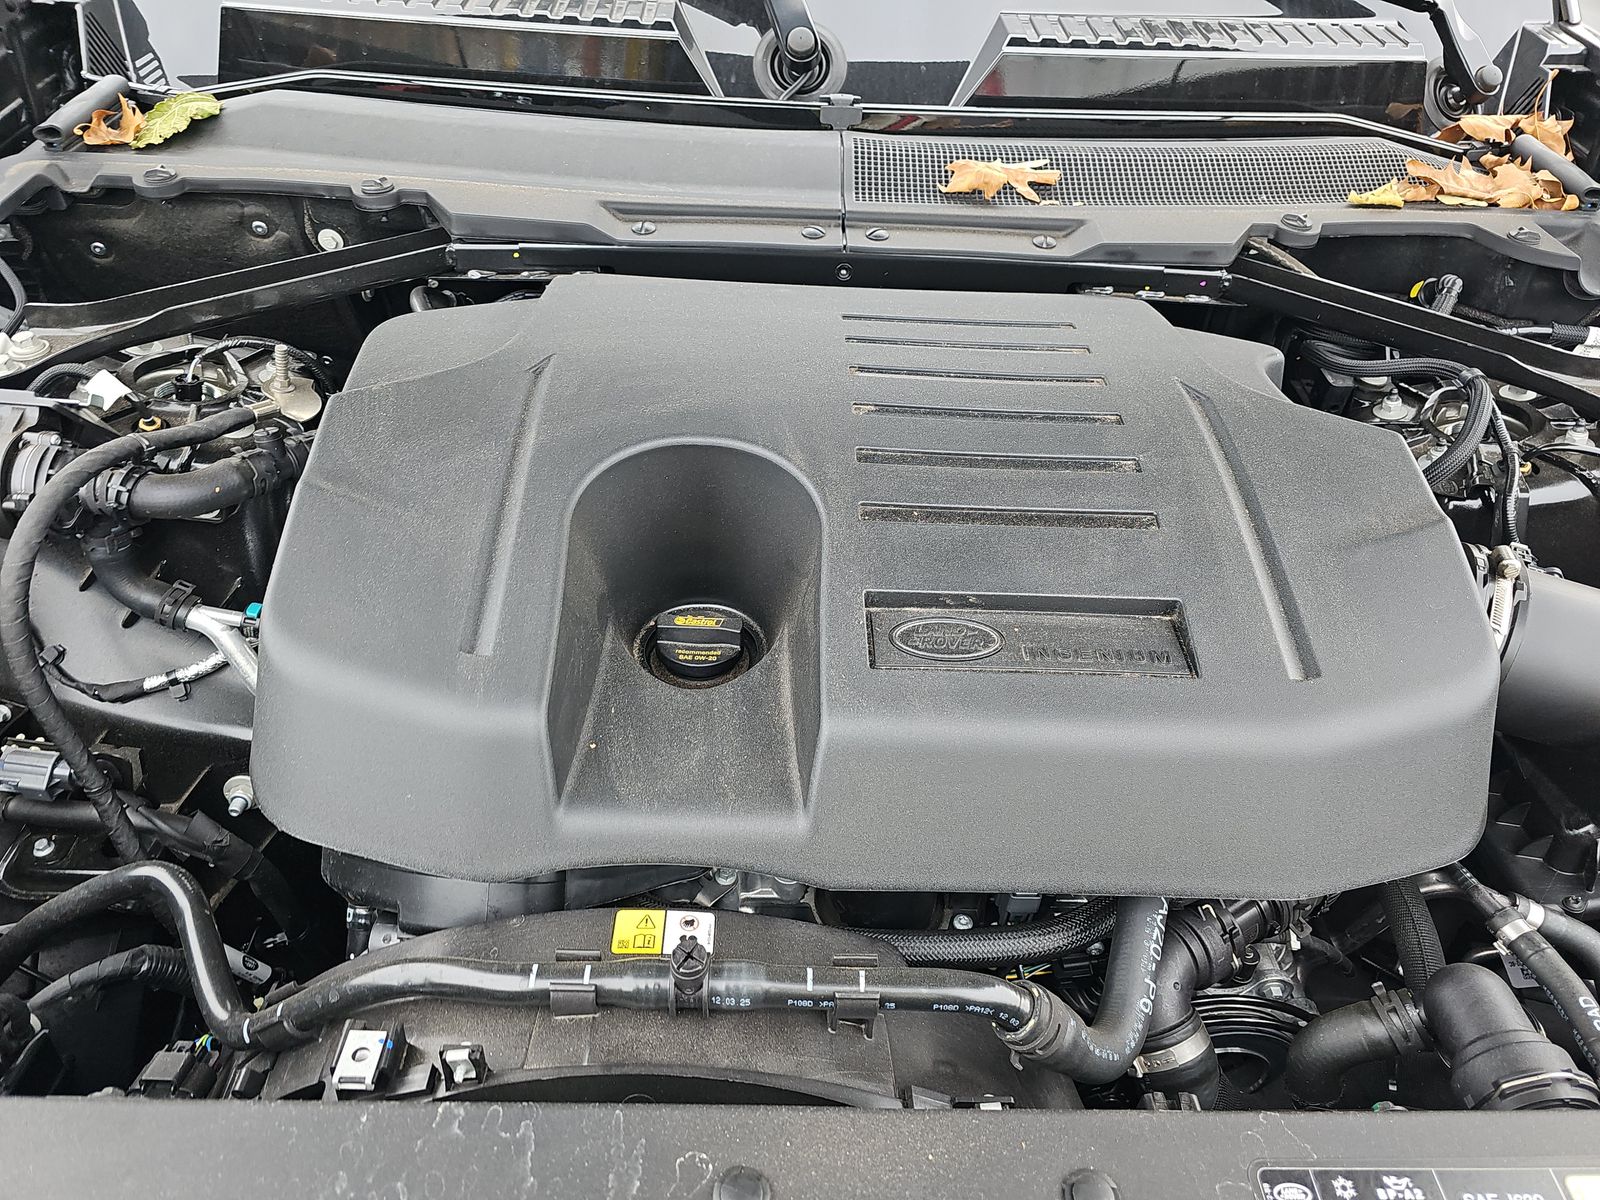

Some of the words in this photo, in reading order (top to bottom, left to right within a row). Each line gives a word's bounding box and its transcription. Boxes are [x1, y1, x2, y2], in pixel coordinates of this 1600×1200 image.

[685, 616, 717, 626] Castrol
[918, 637, 984, 650] ROVER
[1021, 644, 1173, 664] INGENIUM
[711, 996, 751, 1007] 12.03.25
